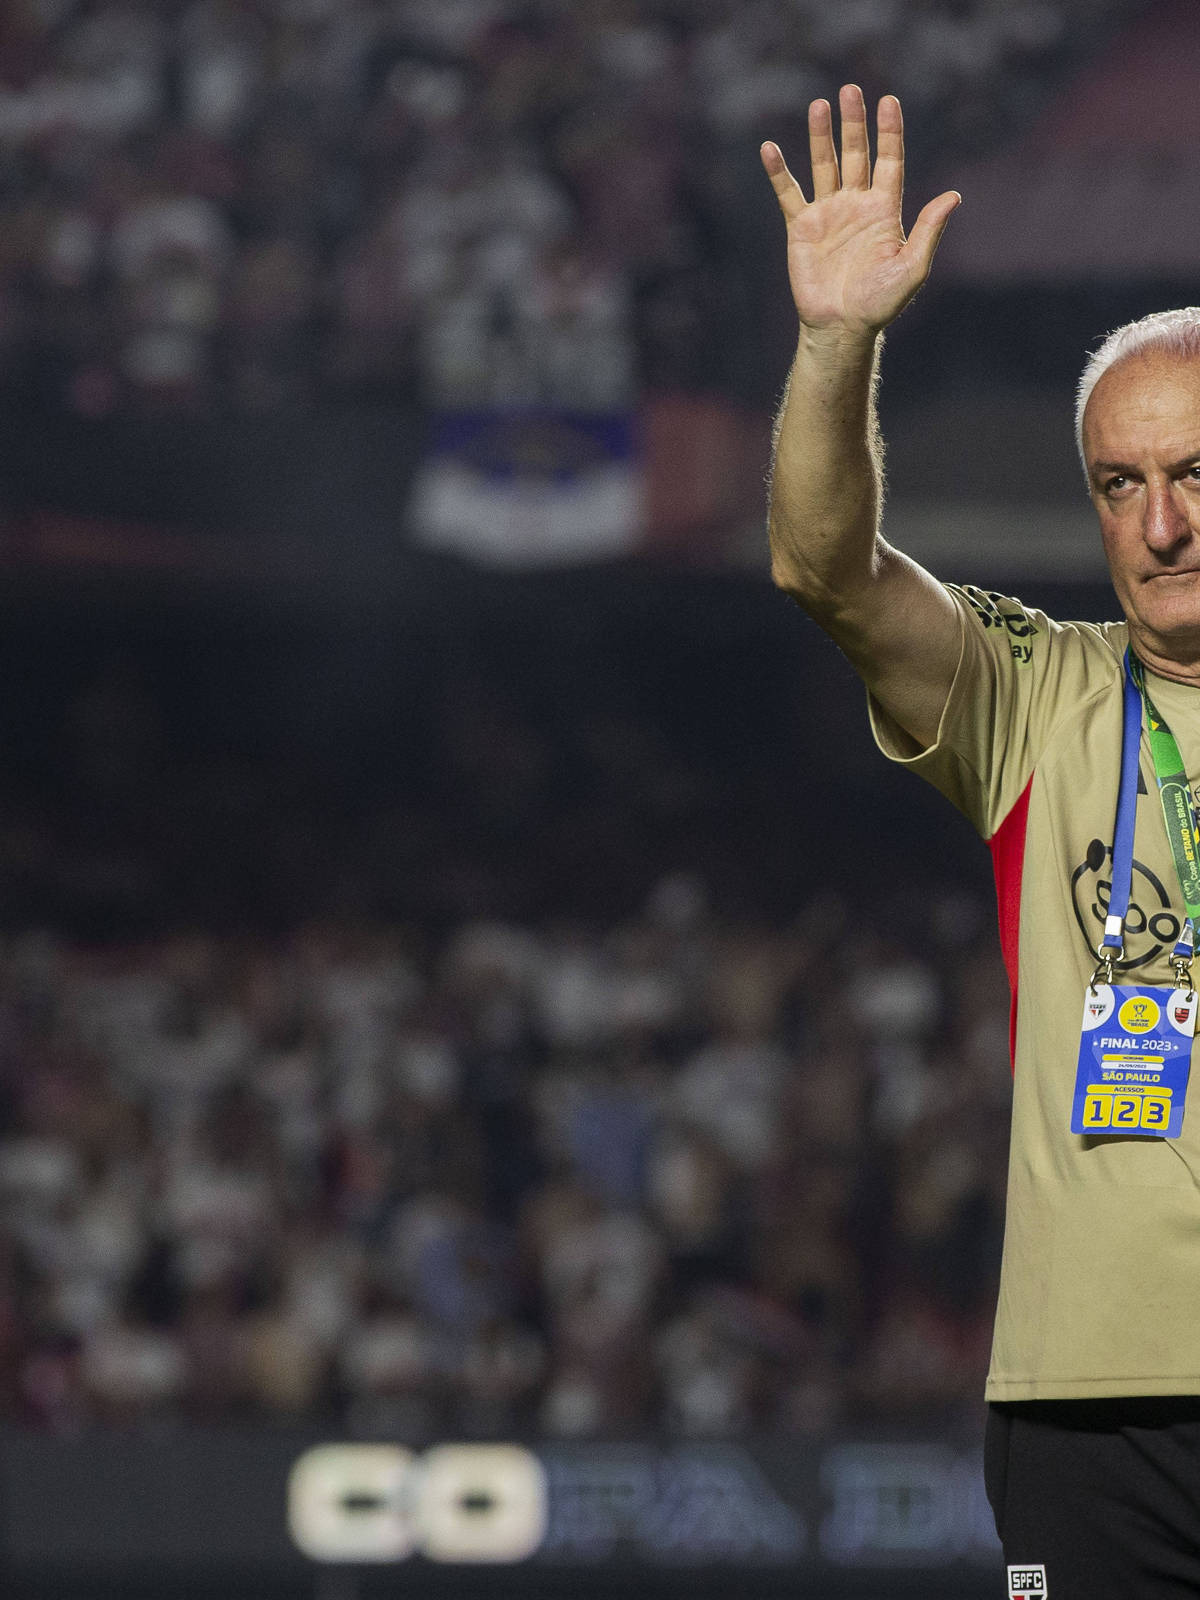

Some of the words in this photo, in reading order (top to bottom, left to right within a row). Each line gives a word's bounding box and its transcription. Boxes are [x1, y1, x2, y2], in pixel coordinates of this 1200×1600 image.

[1174, 791, 1187, 820] BRASIL
[1181, 828, 1195, 862] BETANO
[1100, 1038, 1139, 1049] FINAL
[1141, 1039, 1172, 1052] 2023
[1102, 1070, 1124, 1081] SÃO
[1125, 1072, 1161, 1083] PAULO
[1113, 1086, 1145, 1094] ACESSOS
[1090, 1100, 1103, 1122] 1
[1117, 1101, 1136, 1122] 2
[1146, 1102, 1165, 1124] 3
[1012, 1572, 1042, 1589] SPFC
